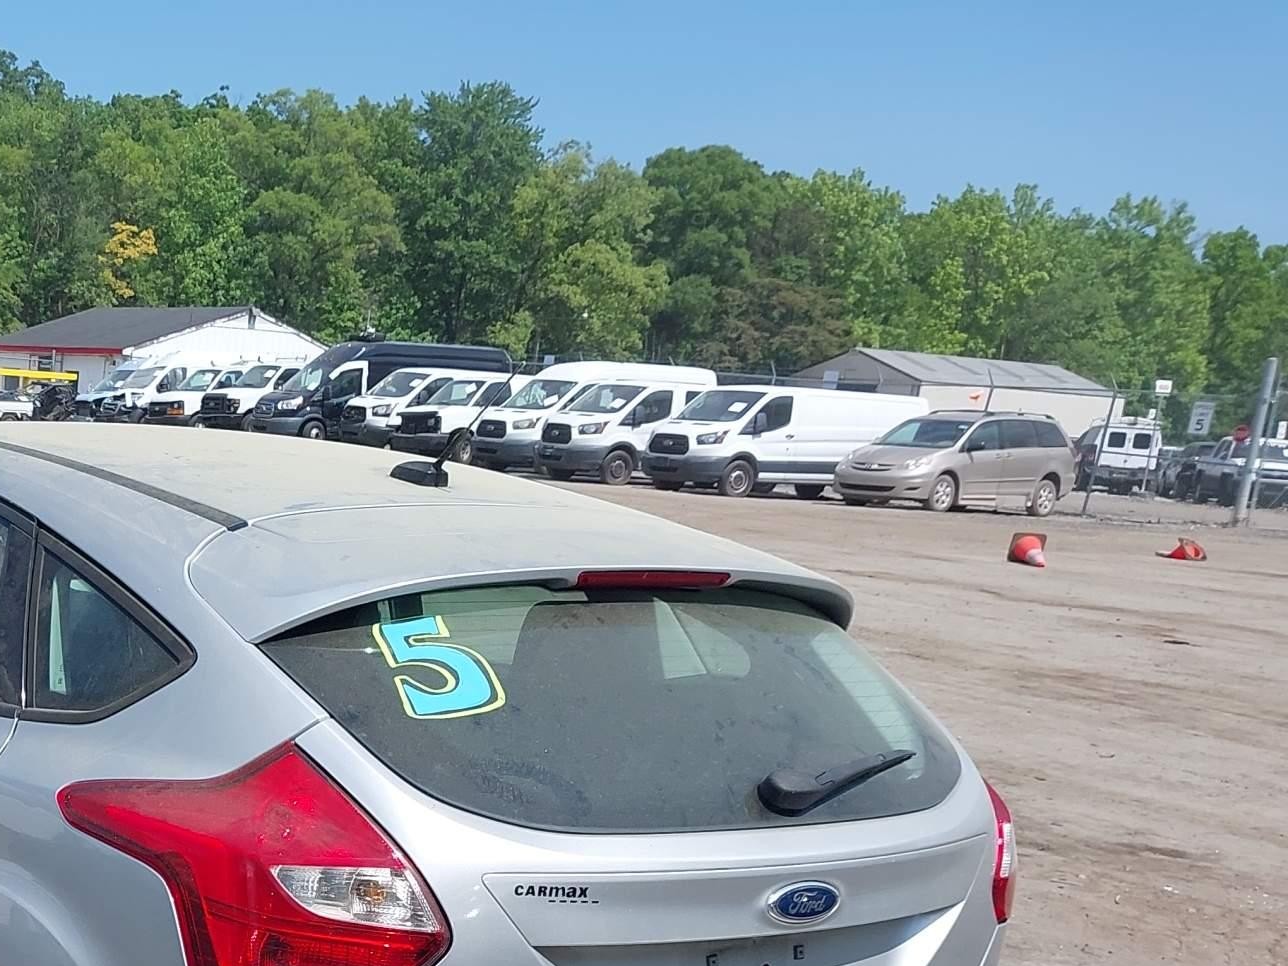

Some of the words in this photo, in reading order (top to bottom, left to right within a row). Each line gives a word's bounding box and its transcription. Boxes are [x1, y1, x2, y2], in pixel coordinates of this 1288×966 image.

[1195, 419, 1205, 431] 5
[371, 615, 506, 720] 5
[789, 891, 826, 914] Ford
